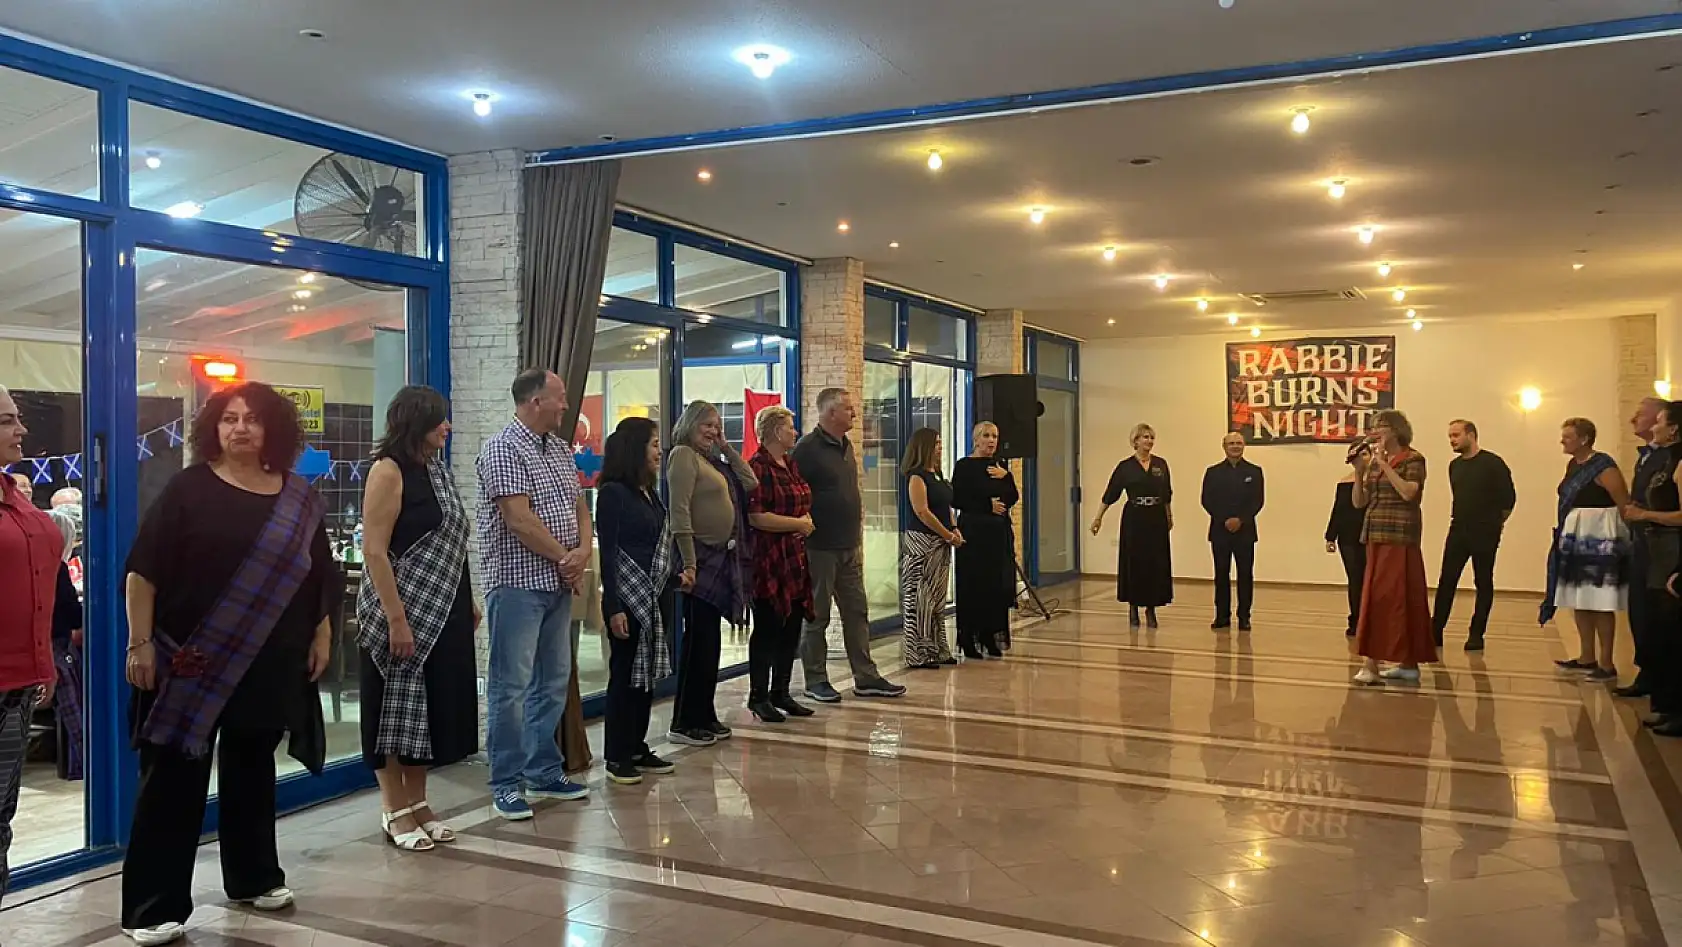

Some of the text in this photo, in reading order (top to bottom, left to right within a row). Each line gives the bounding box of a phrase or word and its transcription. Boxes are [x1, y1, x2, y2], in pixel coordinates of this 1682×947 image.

[1238, 344, 1388, 376] RABBIE
[1246, 376, 1378, 407] BURNS
[1253, 409, 1374, 439] NIGHT
